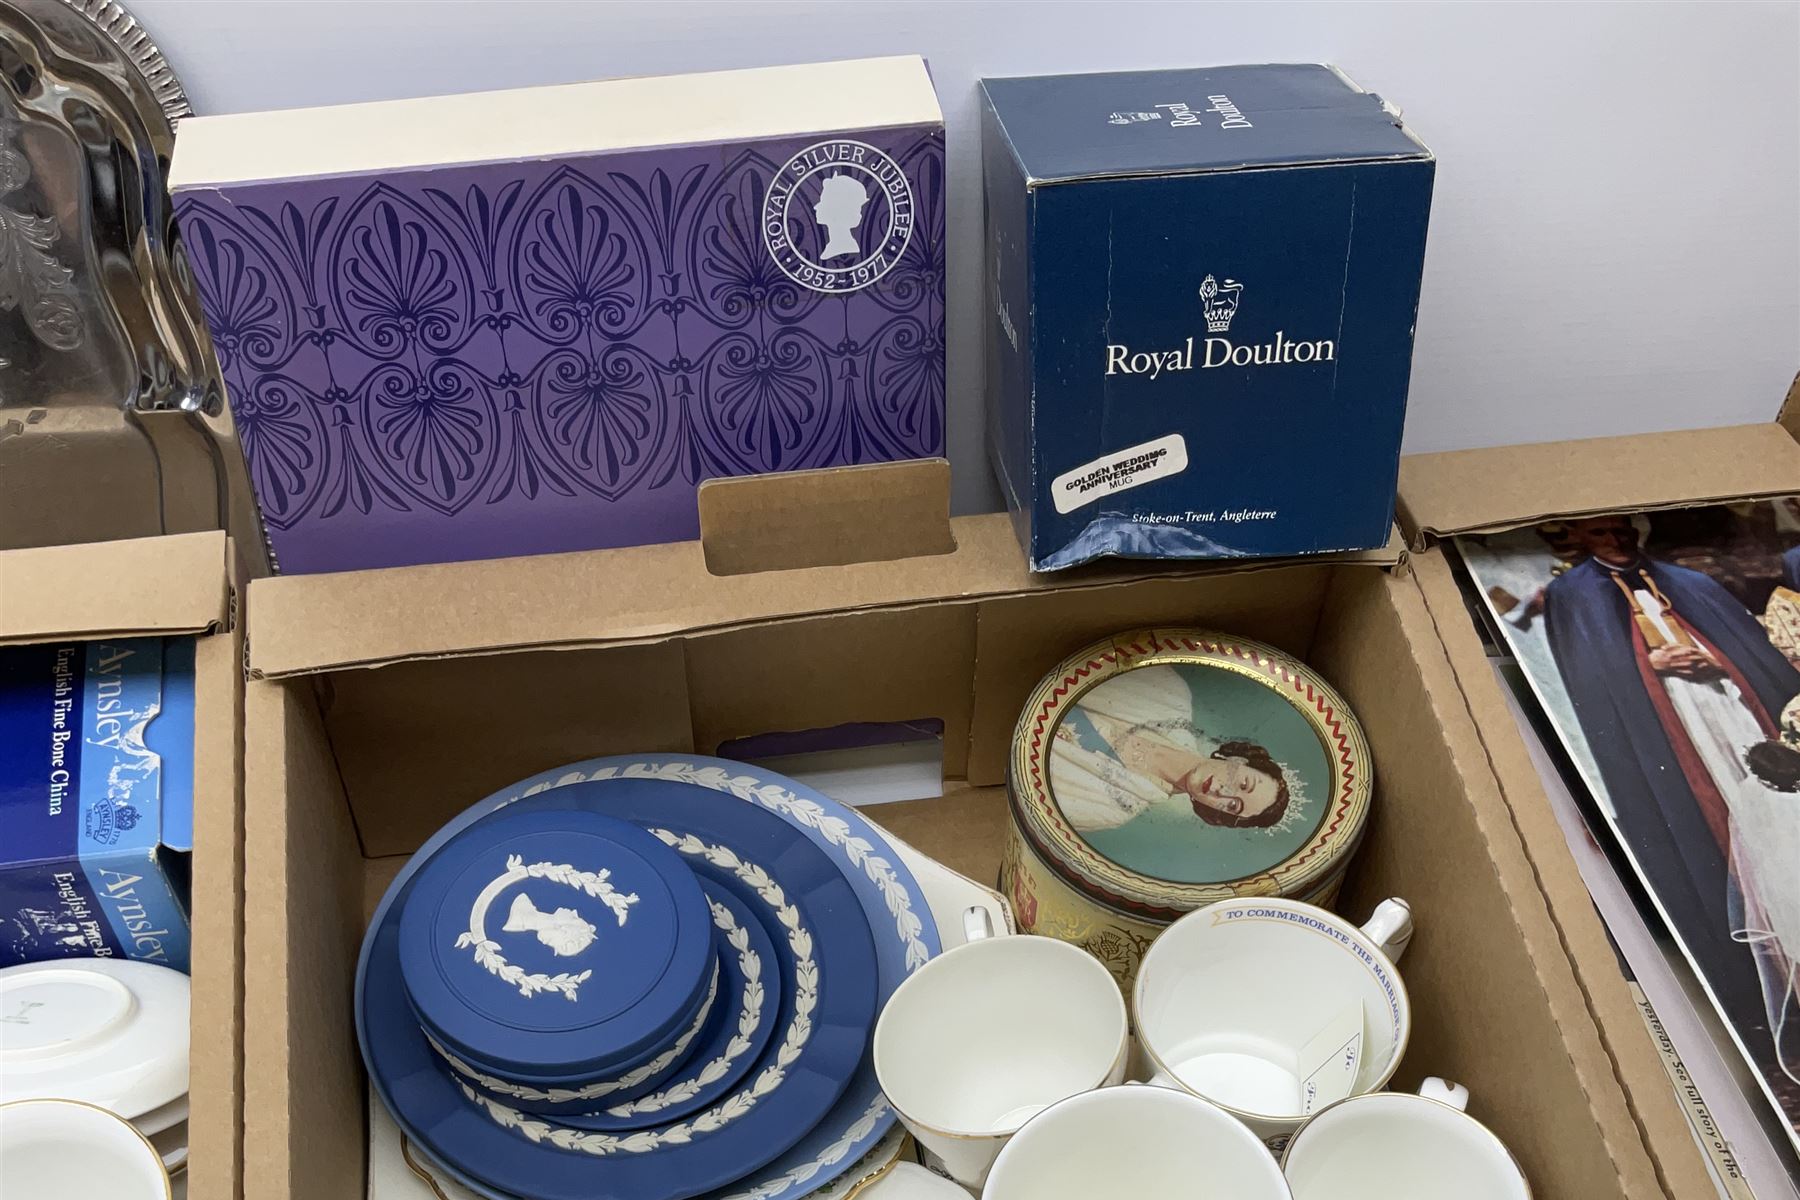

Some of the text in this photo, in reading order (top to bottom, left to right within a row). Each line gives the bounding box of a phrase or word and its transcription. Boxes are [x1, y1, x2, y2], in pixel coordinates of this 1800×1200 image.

[1155, 95, 1253, 130] Royal Doulton
[767, 144, 910, 251] ROYAL SILVER JUBILEE
[1105, 330, 1334, 380] Royal Doulton
[1065, 448, 1167, 491] GOLDEN WEDDING
[1079, 459, 1158, 493] ANNIVERSARY
[1109, 476, 1133, 490] MUG
[1220, 509, 1277, 524] Angleterre
[86, 644, 136, 751] Aynsley
[50, 647, 74, 816] English Fine Bone China
[100, 804, 111, 839] AYNSLEY
[54, 871, 86, 920] English
[99, 867, 168, 963] Aynsley
[1226, 909, 1243, 919] TO
[1246, 909, 1349, 945] COMMEMORATE
[1352, 942, 1373, 965] THE
[1639, 1000, 1738, 1179] yesterday. See full story of the
